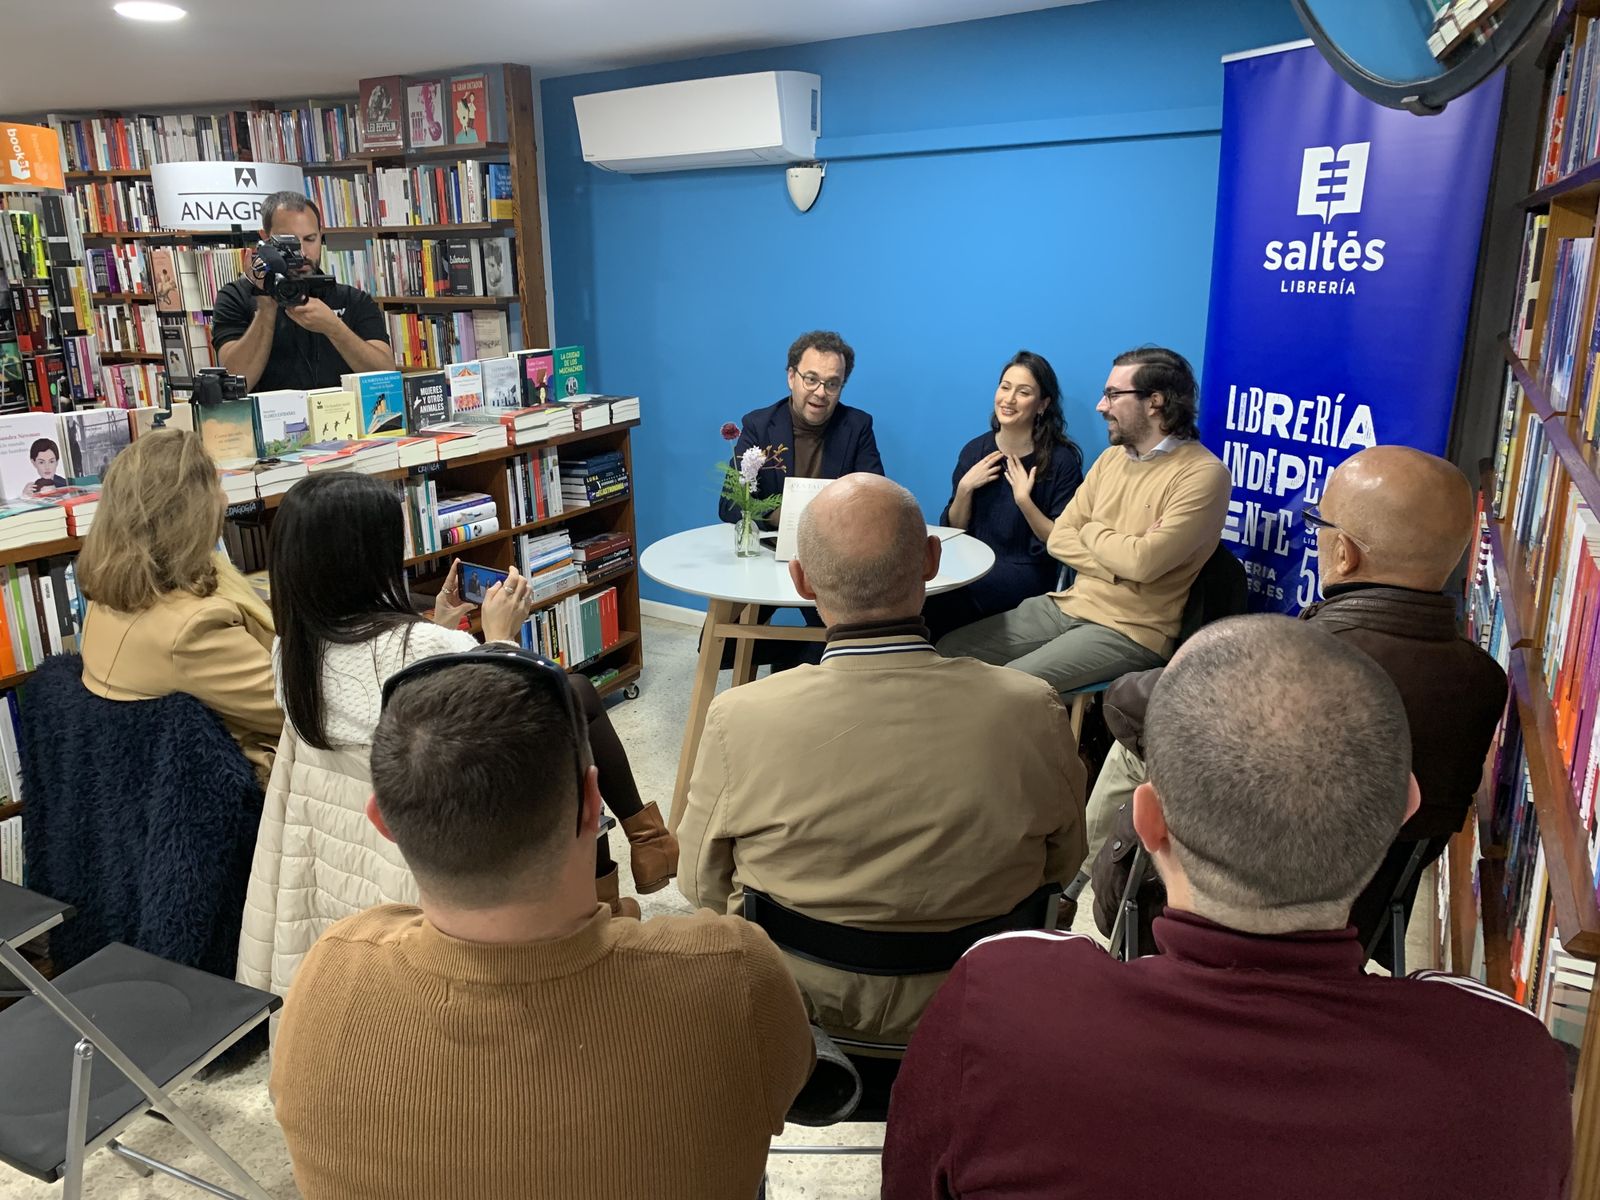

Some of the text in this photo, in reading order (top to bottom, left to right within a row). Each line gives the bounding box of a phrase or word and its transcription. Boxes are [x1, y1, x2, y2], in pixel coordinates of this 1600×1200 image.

[181, 201, 263, 221] ANAGR
[1280, 278, 1356, 295] LIBRERÍA
[559, 365, 583, 375] MUCHACHOS
[420, 385, 443, 395] MUJERES
[427, 394, 444, 404] OTROS
[420, 403, 445, 414] ANIMALES
[1226, 384, 1377, 450] LIBRERÍA
[1223, 440, 1335, 505] INDEPE
[1221, 500, 1293, 557] ENTE
[1240, 559, 1277, 581] ERIA
[1246, 578, 1284, 601] ES.ES
